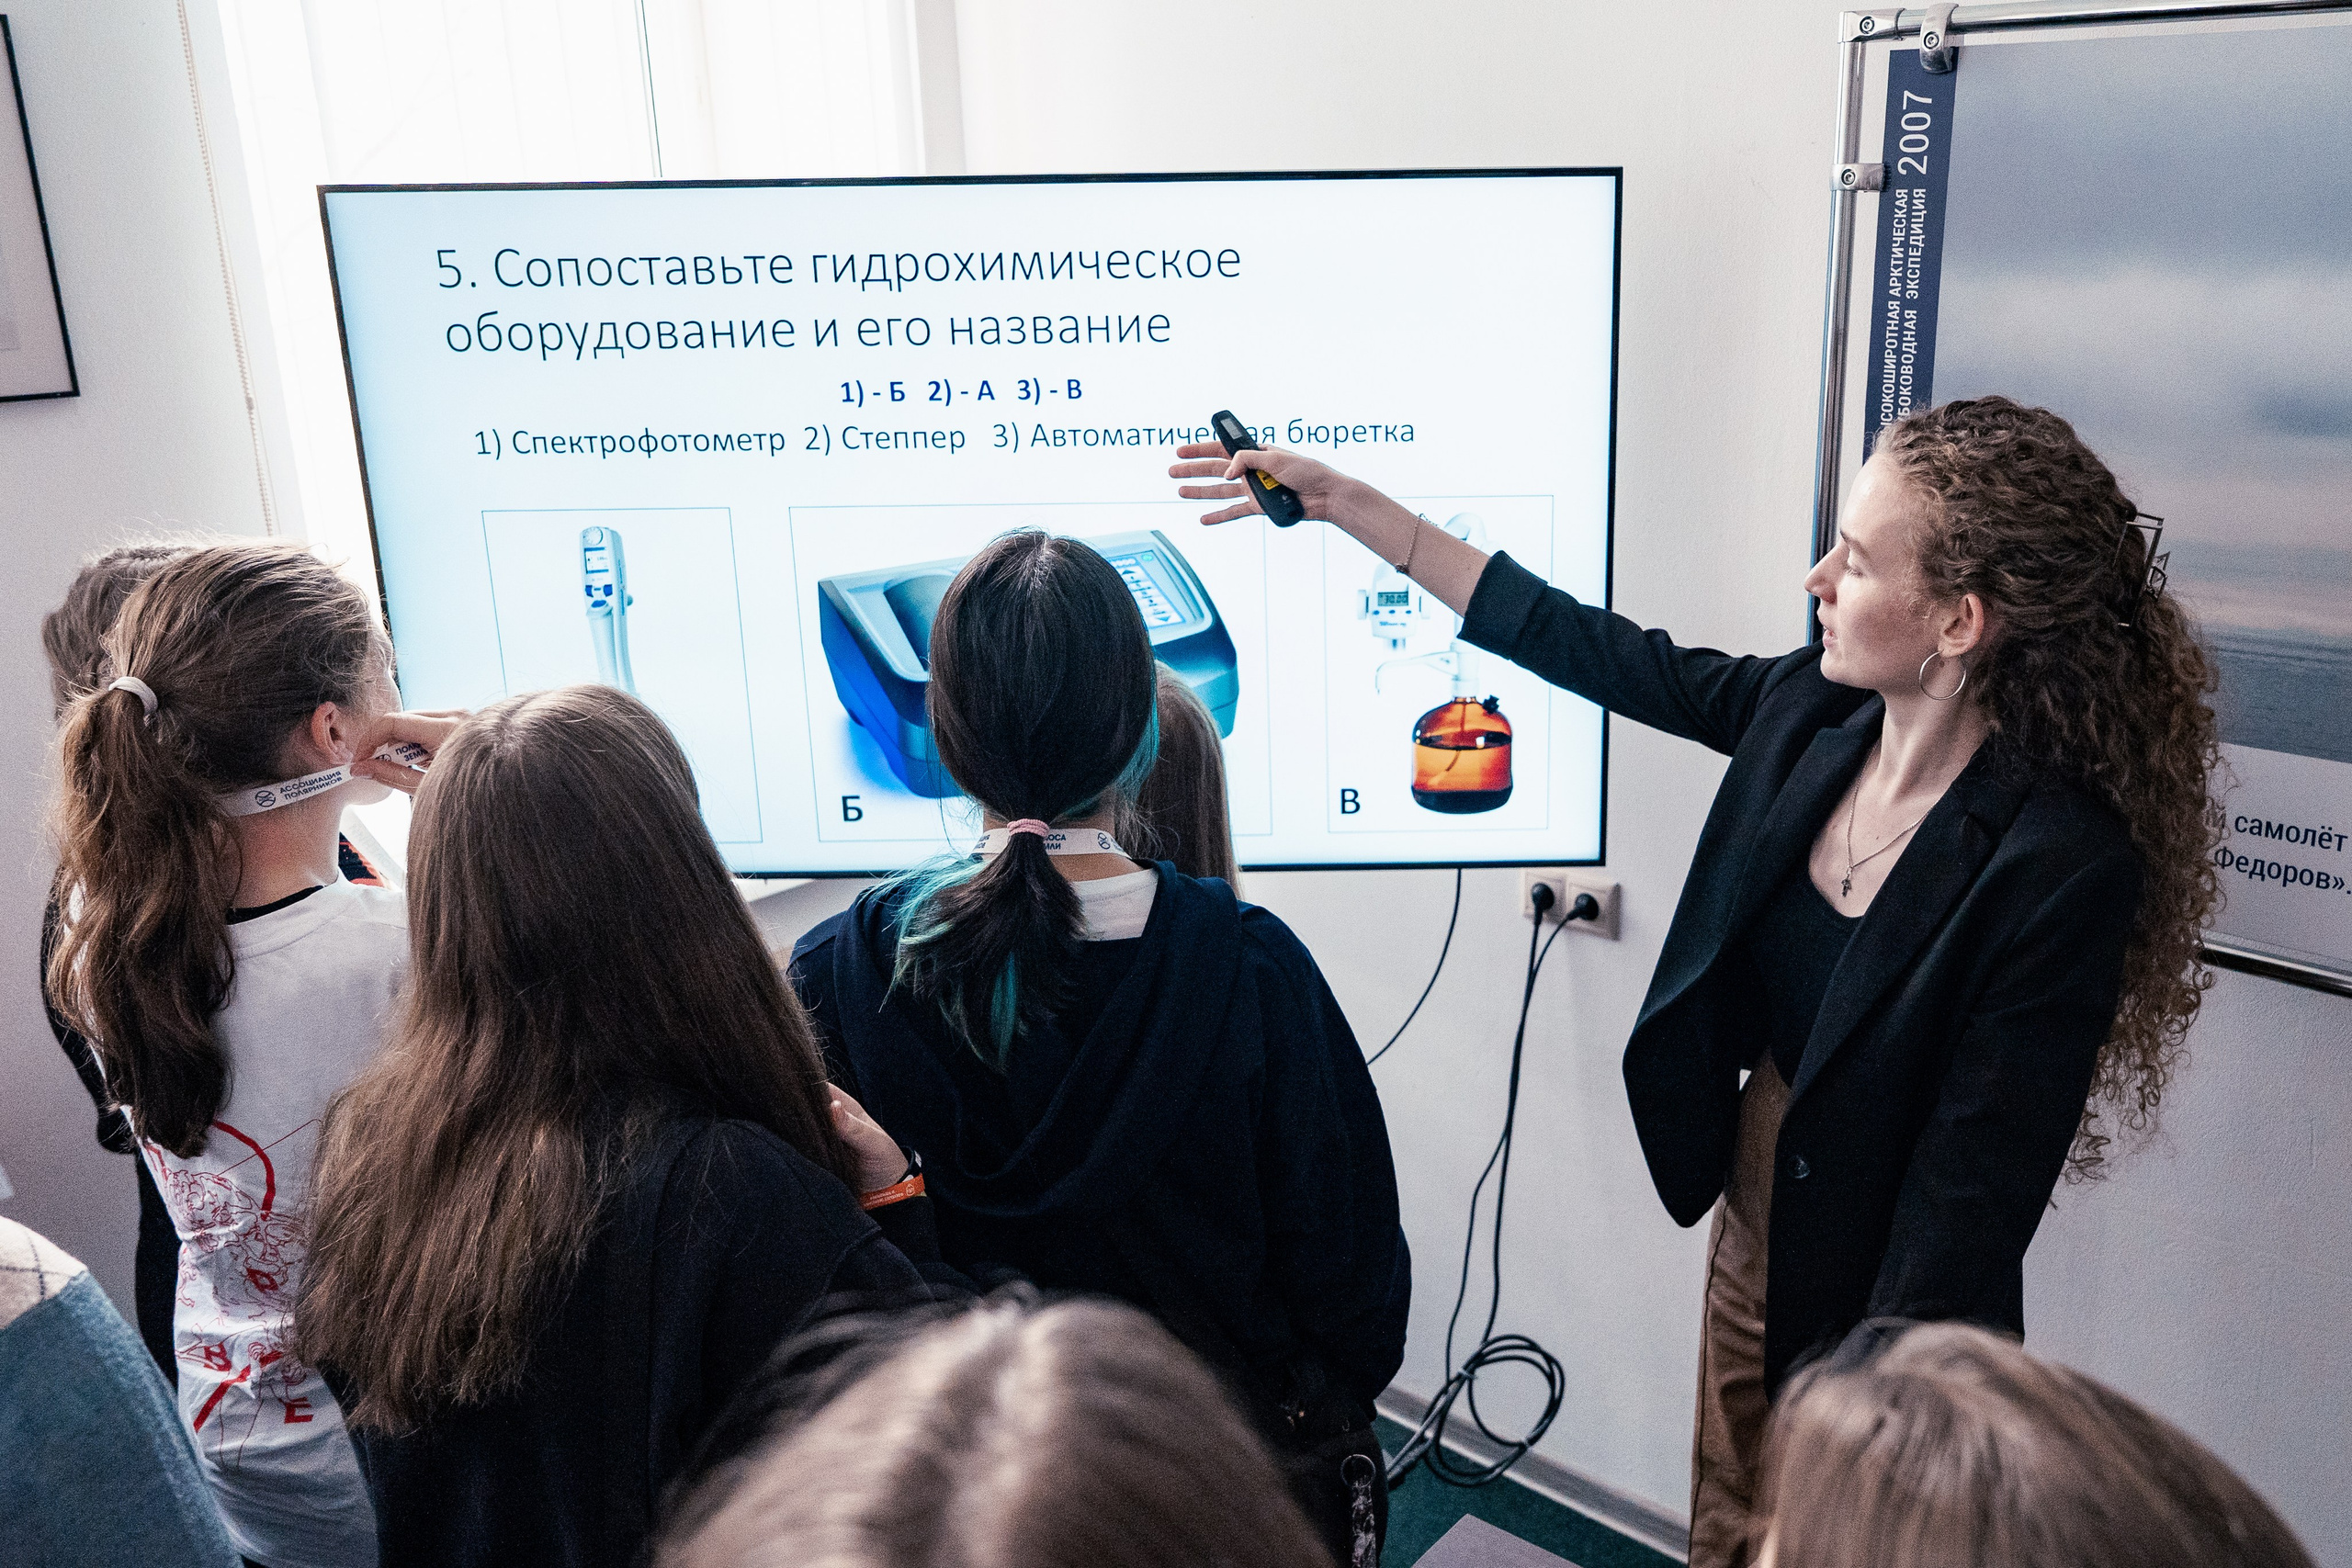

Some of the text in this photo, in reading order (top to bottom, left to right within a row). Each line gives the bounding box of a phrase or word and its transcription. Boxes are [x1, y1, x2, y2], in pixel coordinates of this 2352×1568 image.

[1897, 89, 1933, 175] 2007
[1888, 188, 1909, 298] АРКТИЧЕСКАЯ
[436, 248, 1241, 293] 5. Сопоставьте гидрохимическое
[1896, 188, 1928, 421] БОКОВОДНАЯ ЭКСПЕДИЦИЯ
[446, 310, 1170, 362] оборудование и его название
[841, 379, 865, 409] 1)
[889, 380, 906, 402] Б
[927, 378, 952, 407] 2)
[977, 379, 996, 401] А
[1017, 377, 1041, 406] 3)
[1067, 378, 1082, 400] В
[474, 418, 1415, 461] 1) Спектрофотометр 2) Степпер 3) Автоматичеая бюретка
[279, 771, 342, 794] АССОЦИАЦИЯ
[284, 776, 343, 800] ПОЛЯРНИКОВ
[1340, 787, 1362, 815] В
[841, 795, 864, 823] Б
[2233, 815, 2348, 852] самолёт
[2213, 845, 2352, 896] Федоров».
